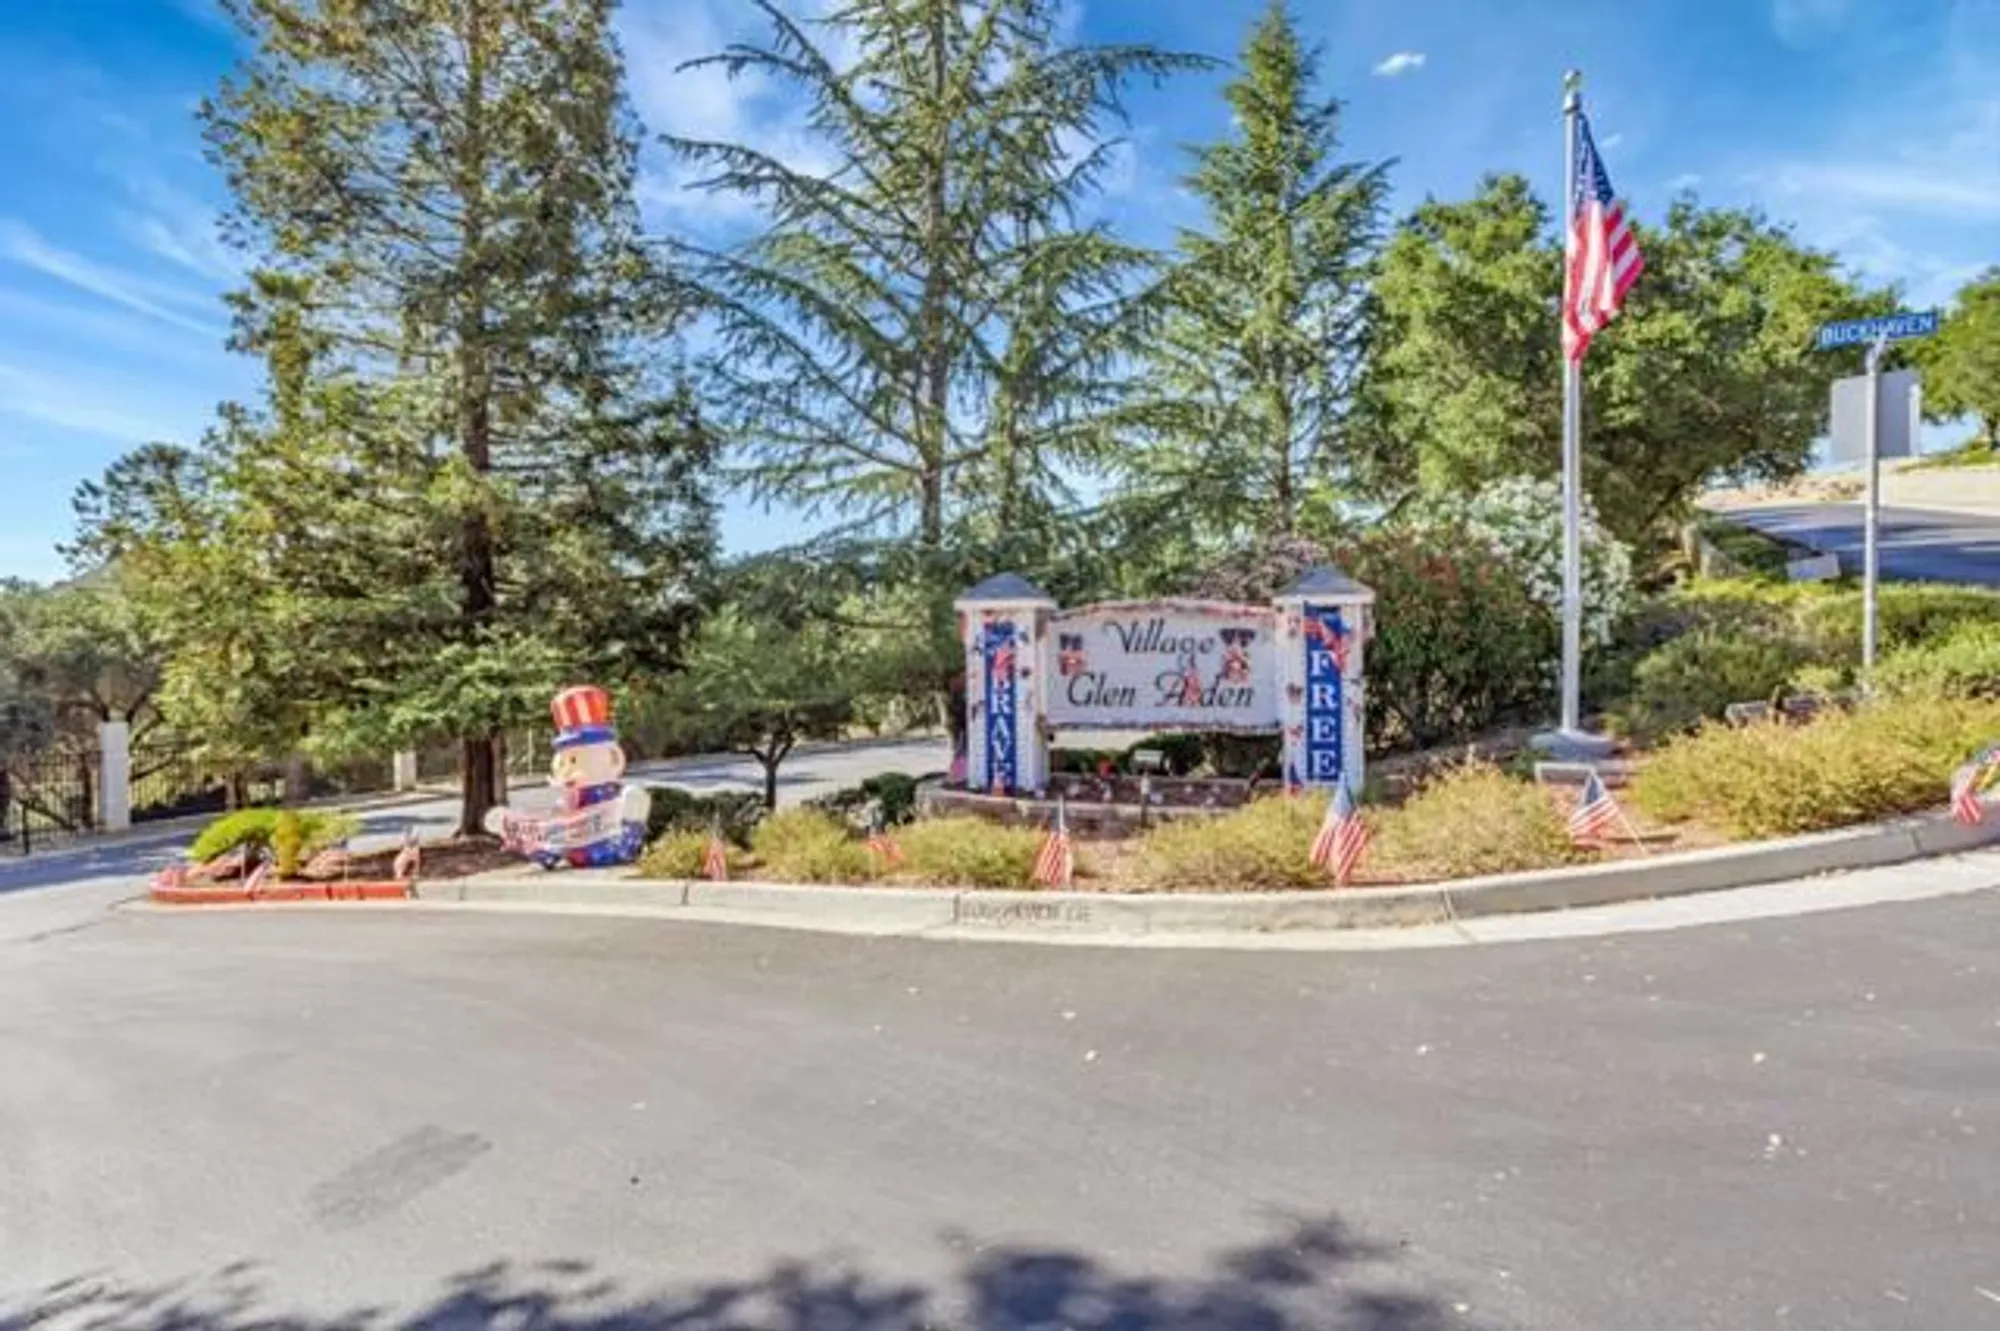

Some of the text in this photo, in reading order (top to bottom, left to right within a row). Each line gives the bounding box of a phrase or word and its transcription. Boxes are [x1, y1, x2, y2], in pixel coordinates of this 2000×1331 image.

[1102, 616, 1216, 670] Village
[1067, 670, 1256, 708] Glen Aden
[1310, 650, 1337, 776] FREE
